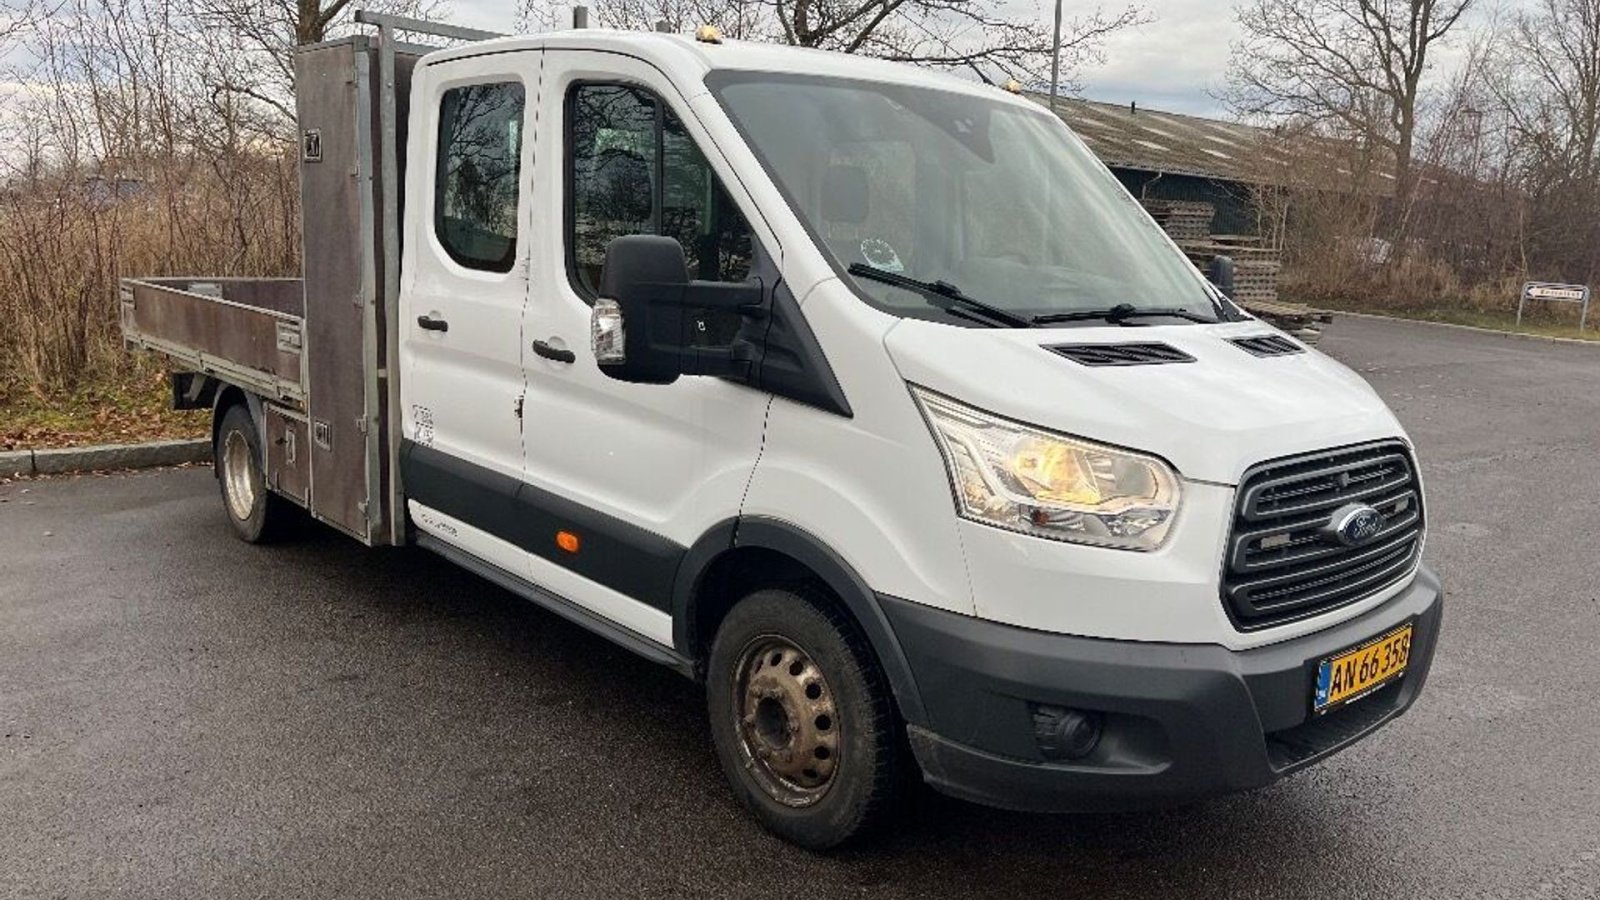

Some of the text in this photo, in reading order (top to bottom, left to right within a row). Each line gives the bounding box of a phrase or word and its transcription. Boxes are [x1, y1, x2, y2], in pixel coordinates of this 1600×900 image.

[1354, 514, 1381, 538] Ford
[1330, 633, 1409, 697] AN 66 358
